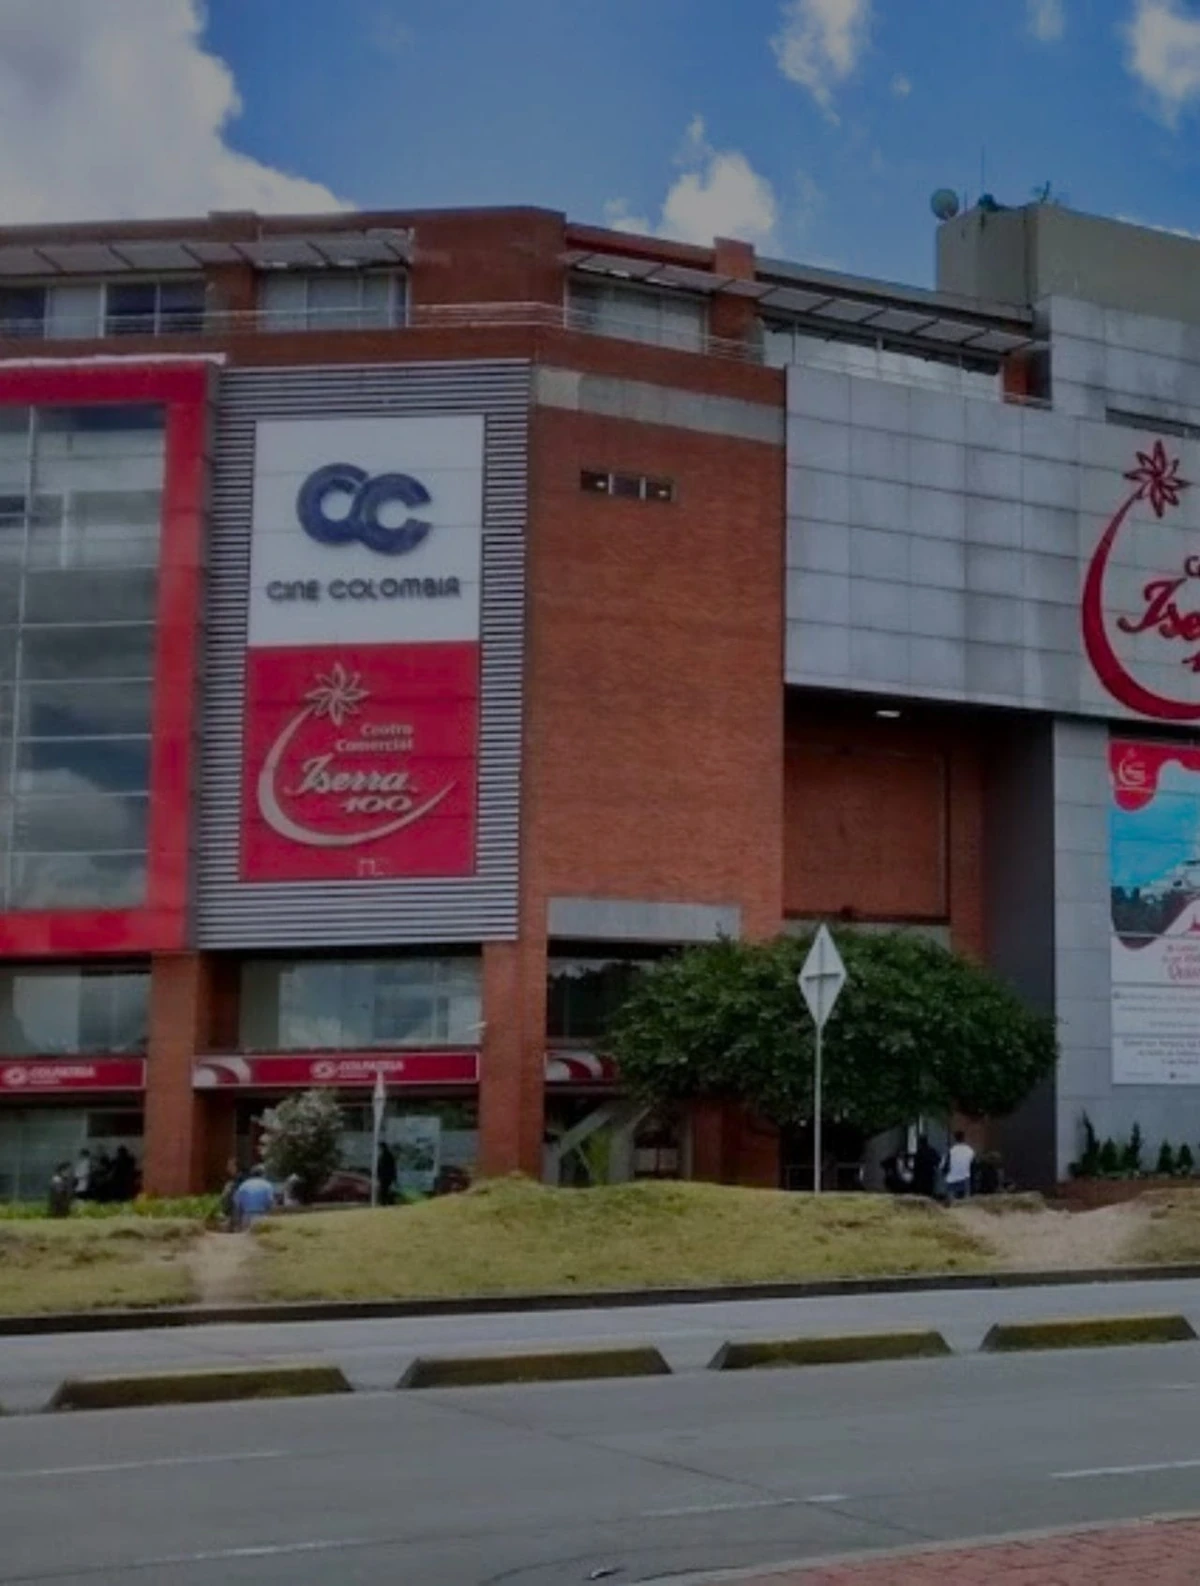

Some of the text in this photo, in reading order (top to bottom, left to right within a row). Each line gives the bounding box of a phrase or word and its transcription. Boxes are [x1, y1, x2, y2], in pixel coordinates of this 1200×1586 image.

[267, 576, 461, 601] CINE COLOMBIA
[360, 723, 413, 736] Centro
[335, 737, 413, 752] Comercial
[283, 753, 418, 796] Iserra
[340, 795, 413, 813] 100
